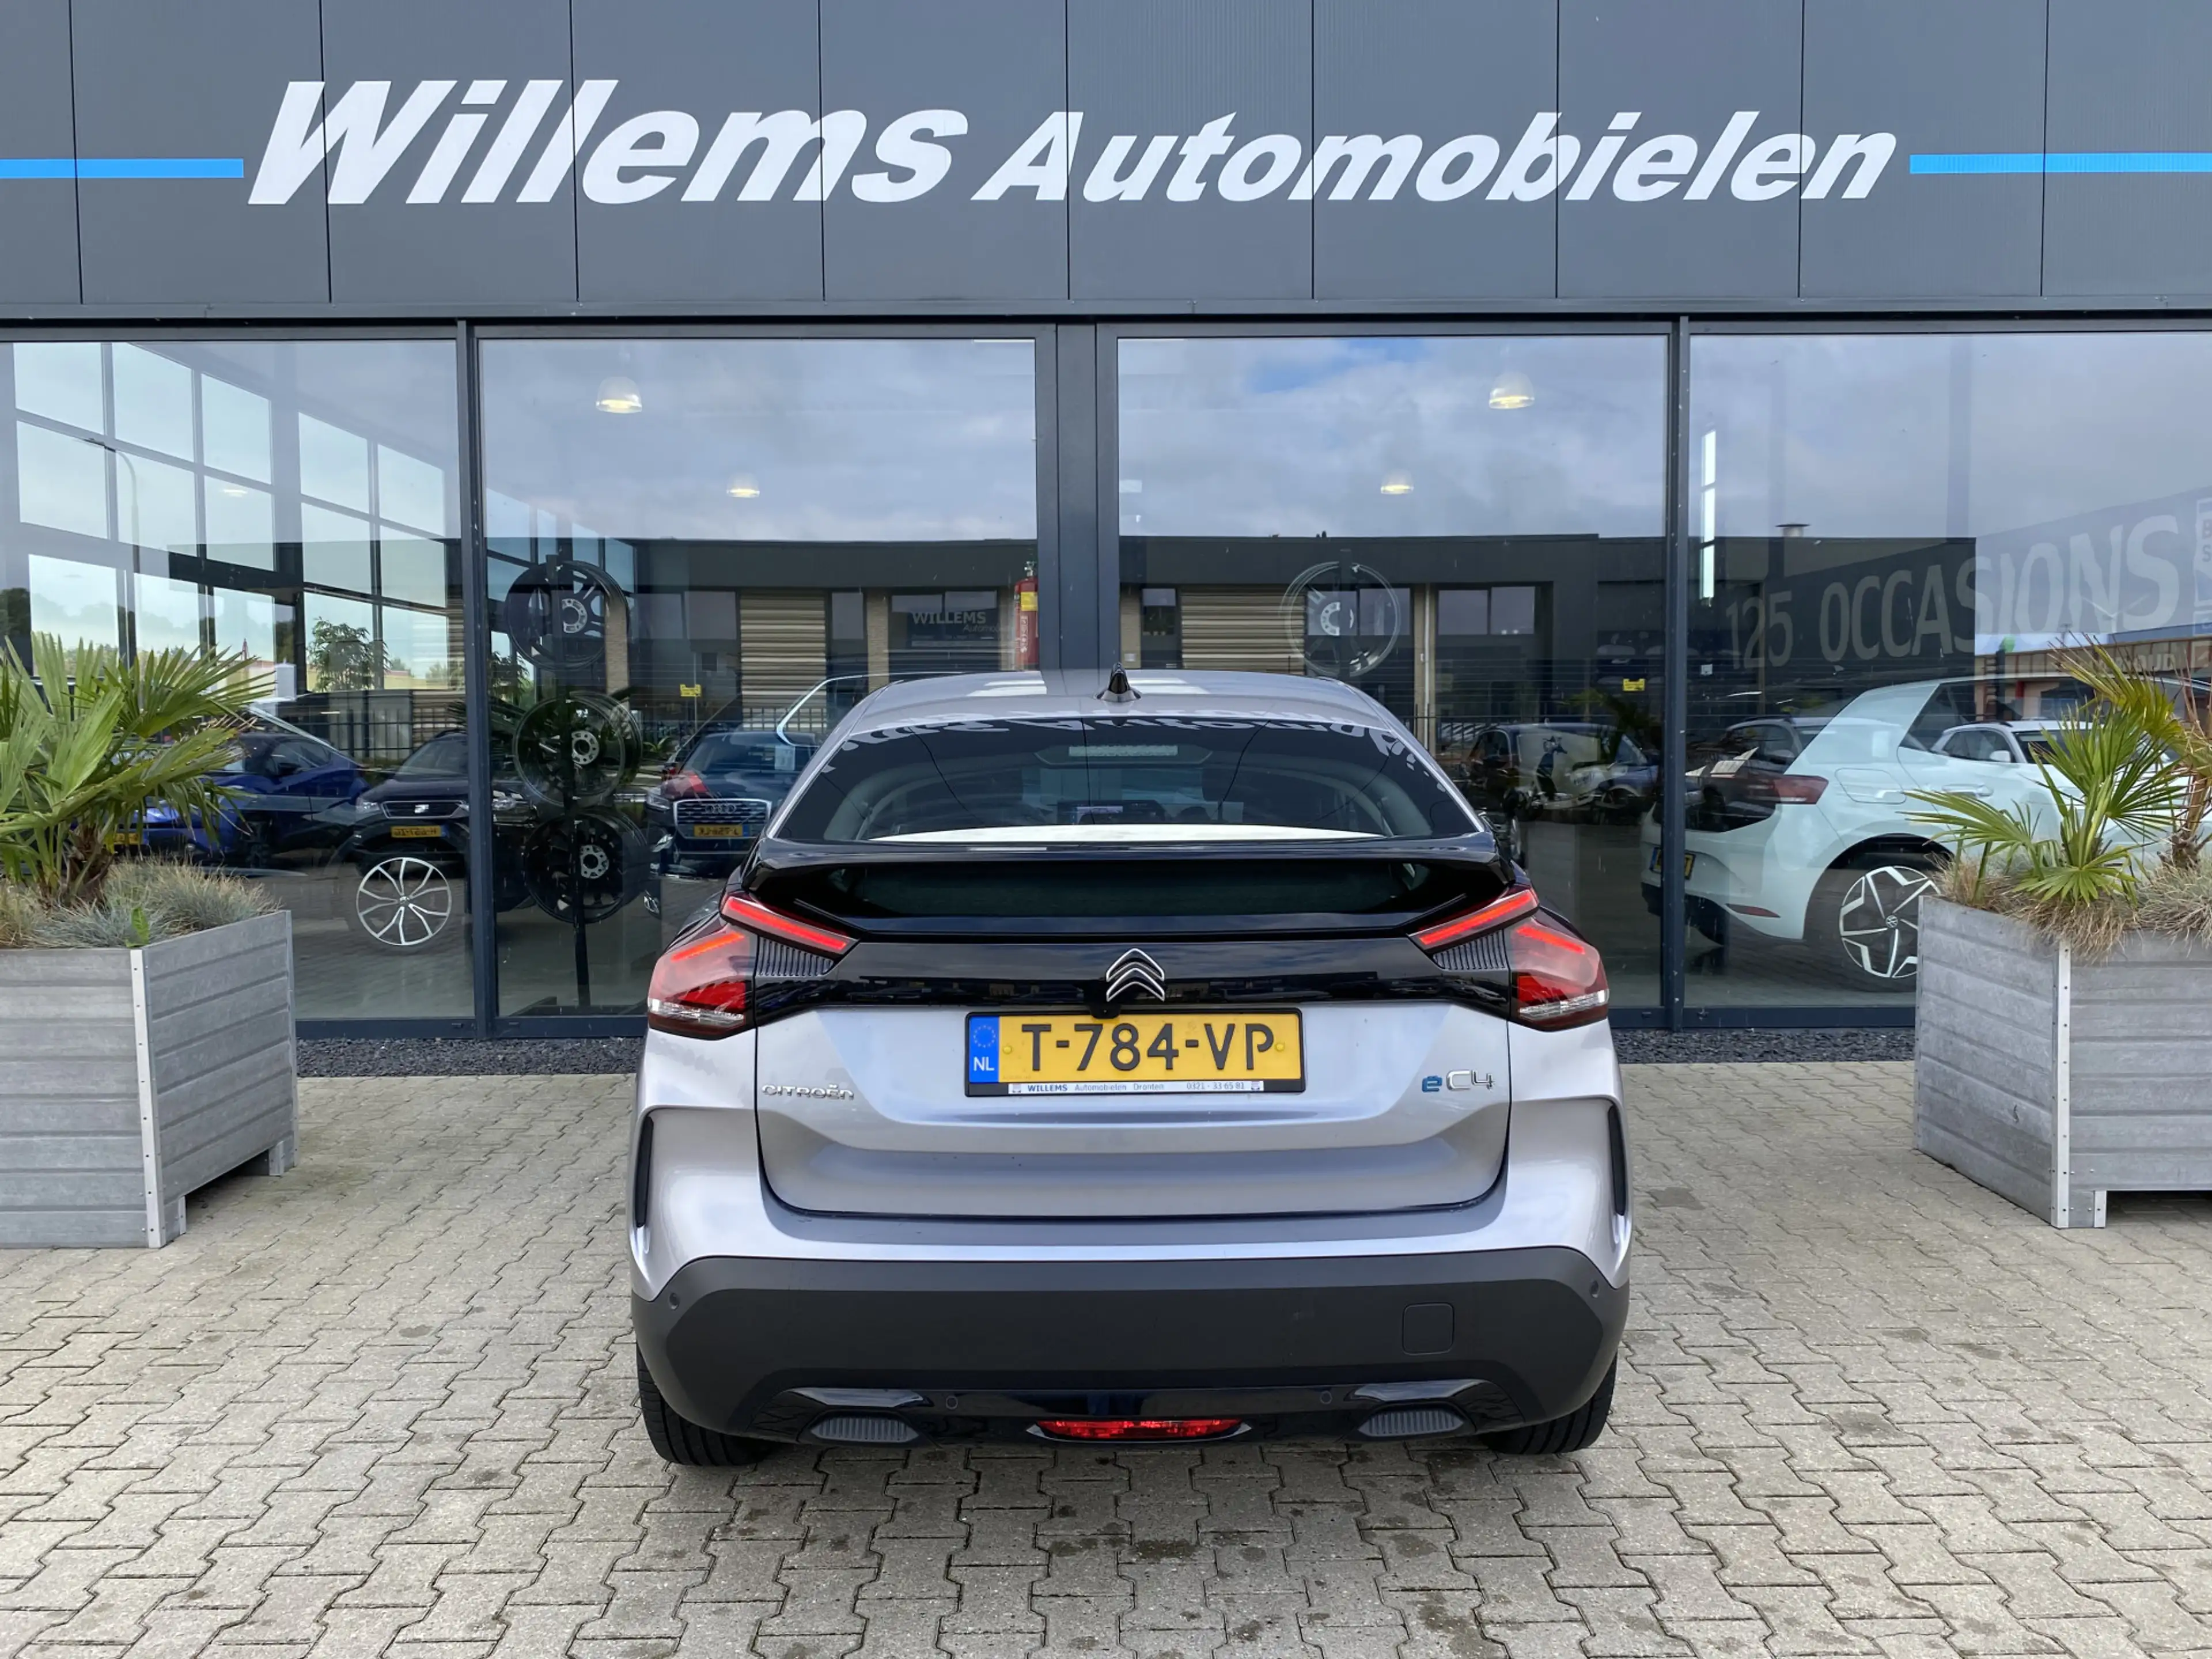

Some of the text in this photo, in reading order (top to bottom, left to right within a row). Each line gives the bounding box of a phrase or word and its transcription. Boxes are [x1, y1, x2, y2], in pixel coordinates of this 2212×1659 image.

[248, 79, 1896, 204] Willems Automobielen
[1725, 514, 2180, 671] 125 OCCASIONS
[912, 611, 987, 625] WILLEMS
[1021, 1022, 1274, 1071] T-784-VP
[973, 1056, 995, 1072] NL
[1027, 1084, 1068, 1092] WILLEMS
[1074, 1084, 1127, 1092] Automobielen
[1187, 1082, 1205, 1090] 0321
[1213, 1082, 1222, 1090] 33
[1224, 1082, 1234, 1090] 65
